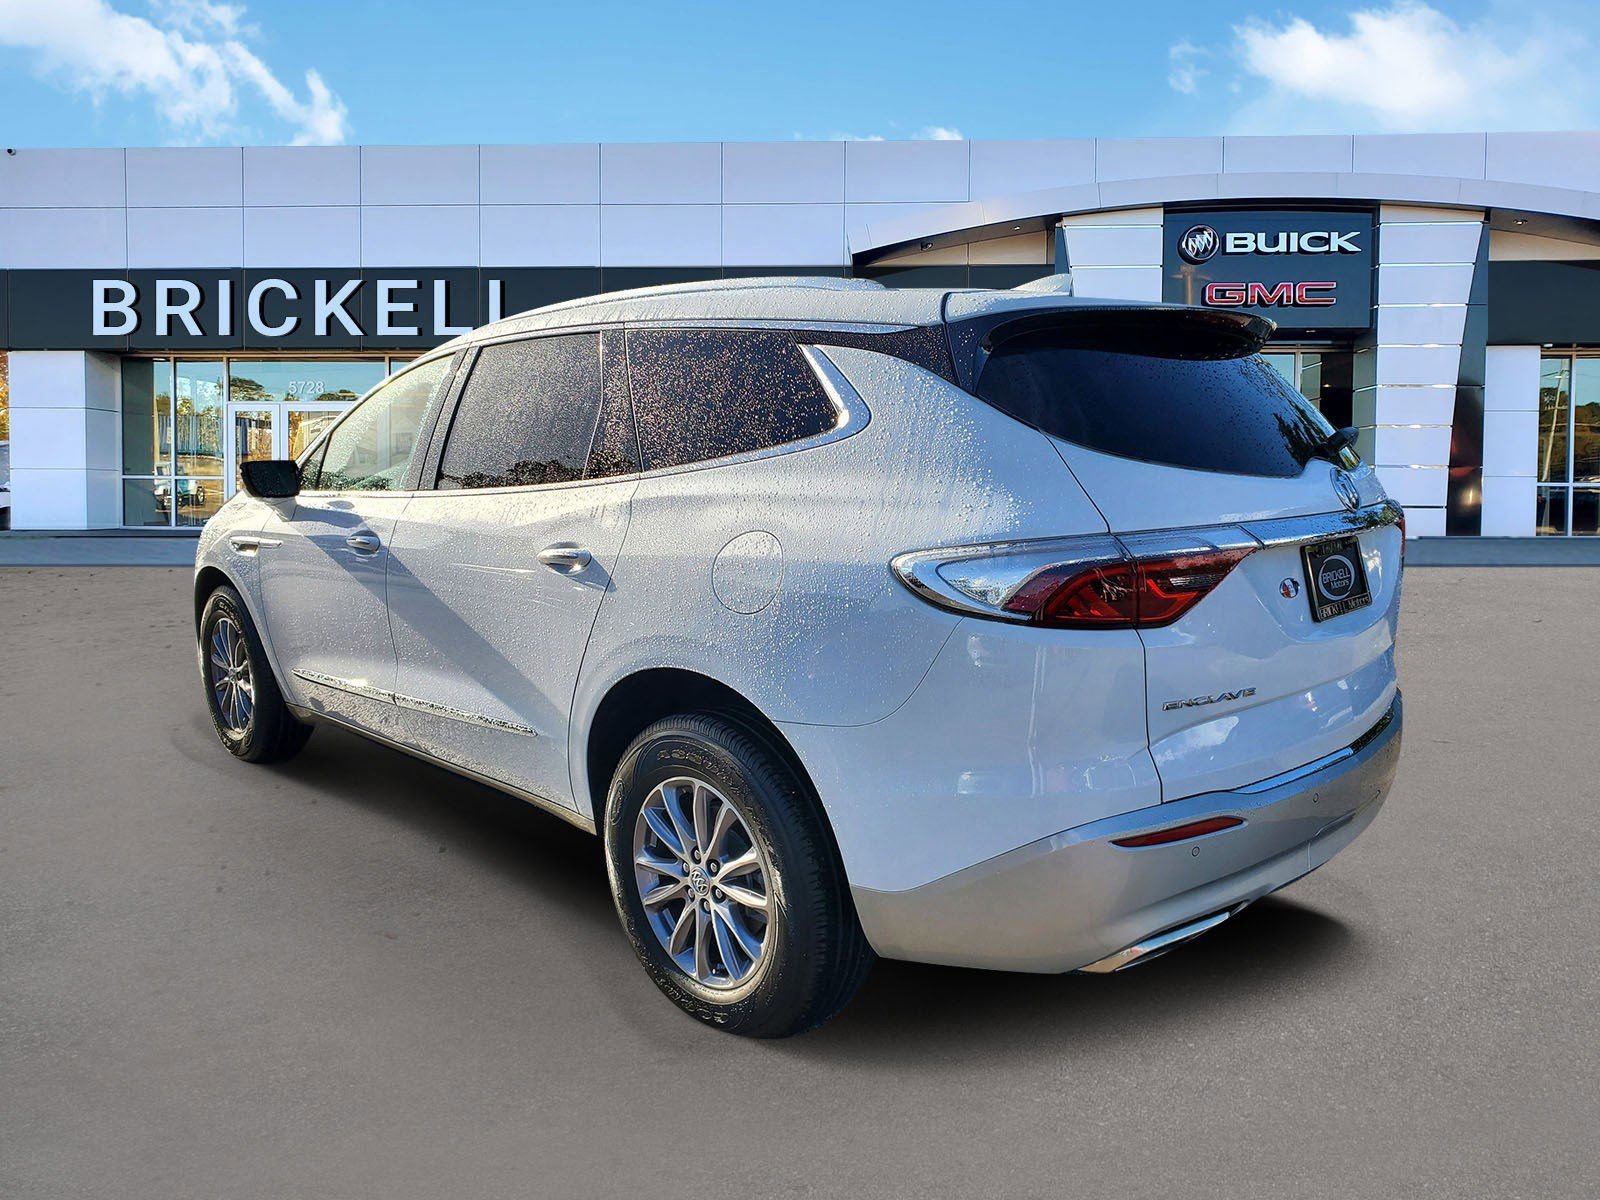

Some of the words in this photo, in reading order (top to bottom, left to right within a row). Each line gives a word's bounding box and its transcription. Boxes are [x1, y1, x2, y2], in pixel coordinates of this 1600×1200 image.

[1225, 231, 1362, 253] BUICK
[1205, 281, 1337, 305] GMC
[288, 380, 325, 395] 5728
[1322, 567, 1351, 584] BRICKELL
[1162, 687, 1257, 711] ENCLAVE
